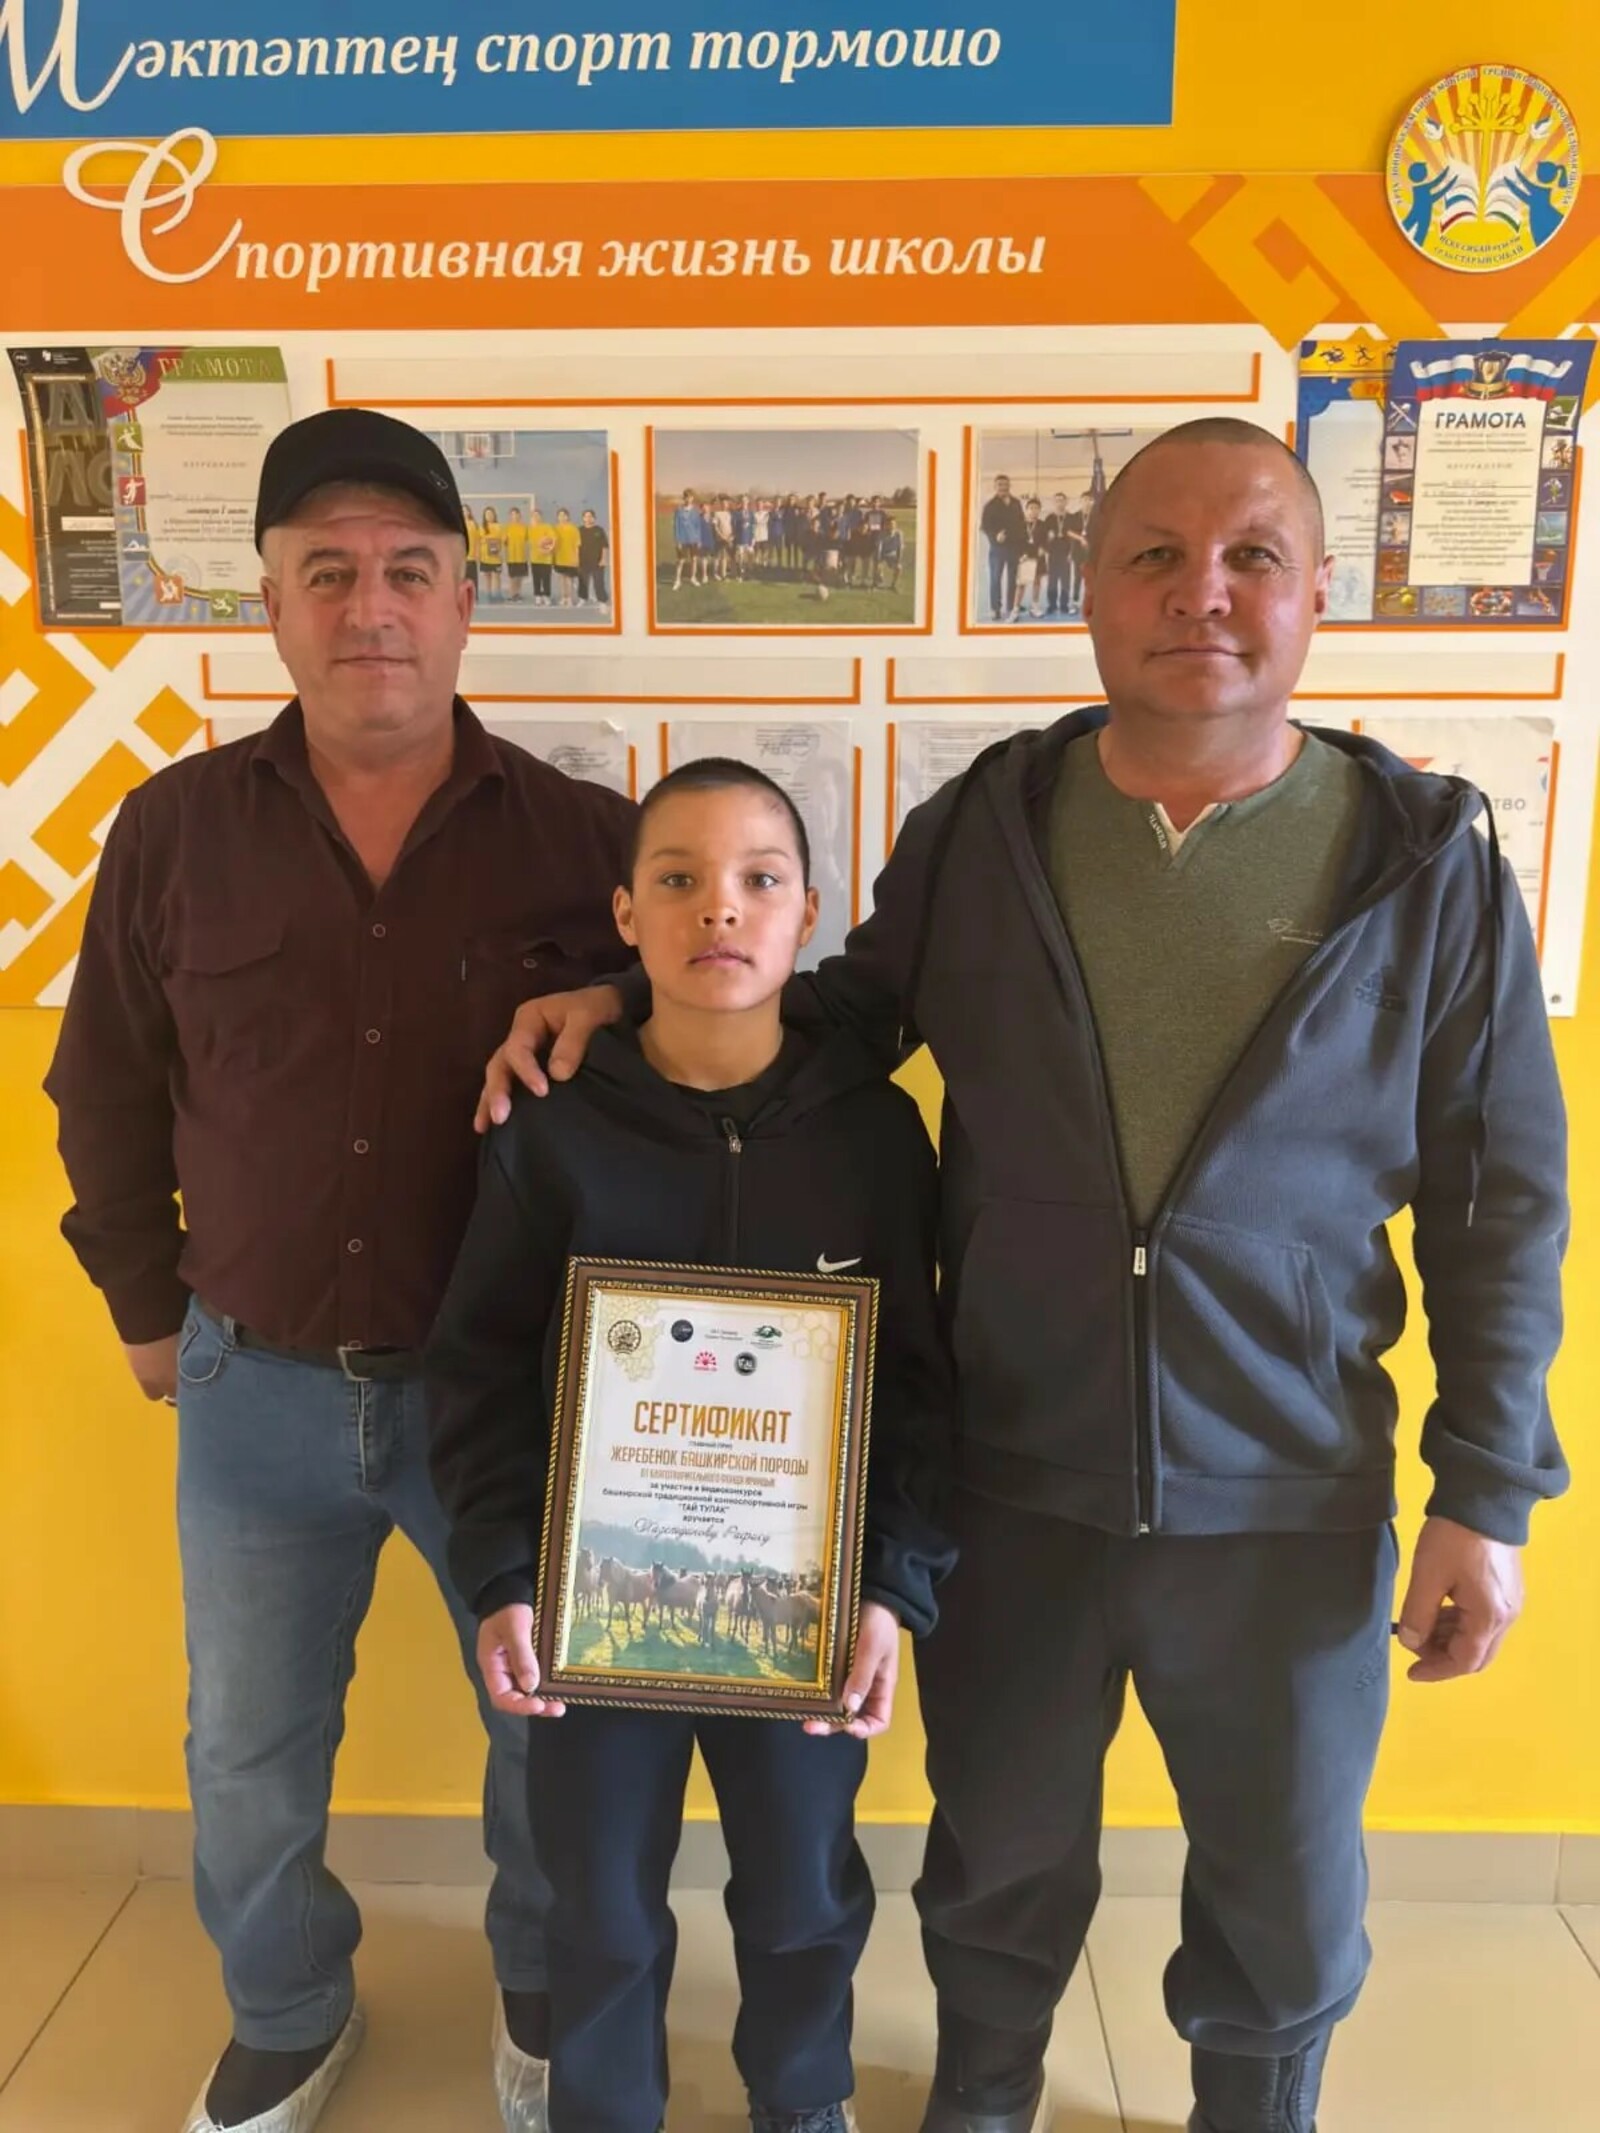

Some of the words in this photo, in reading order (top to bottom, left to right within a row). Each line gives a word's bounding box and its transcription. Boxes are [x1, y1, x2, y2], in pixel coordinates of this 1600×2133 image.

[0, 0, 458, 114] Мәктәптең
[476, 31, 671, 86] спорт
[689, 27, 1001, 84] тормошо
[63, 127, 583, 292] Спортивная
[598, 237, 811, 277] жизнь
[829, 236, 1046, 276] школы
[158, 356, 276, 378] ГРАМОТА
[1435, 411, 1526, 429] ГРАМОТА
[634, 1401, 791, 1443] СЕРТИФИКАТ
[611, 1446, 678, 1466] ЖЕРЕБЕНОК
[681, 1450, 757, 1472] БАШКИРСКОЙ
[760, 1456, 809, 1476] ПОРОДЫ
